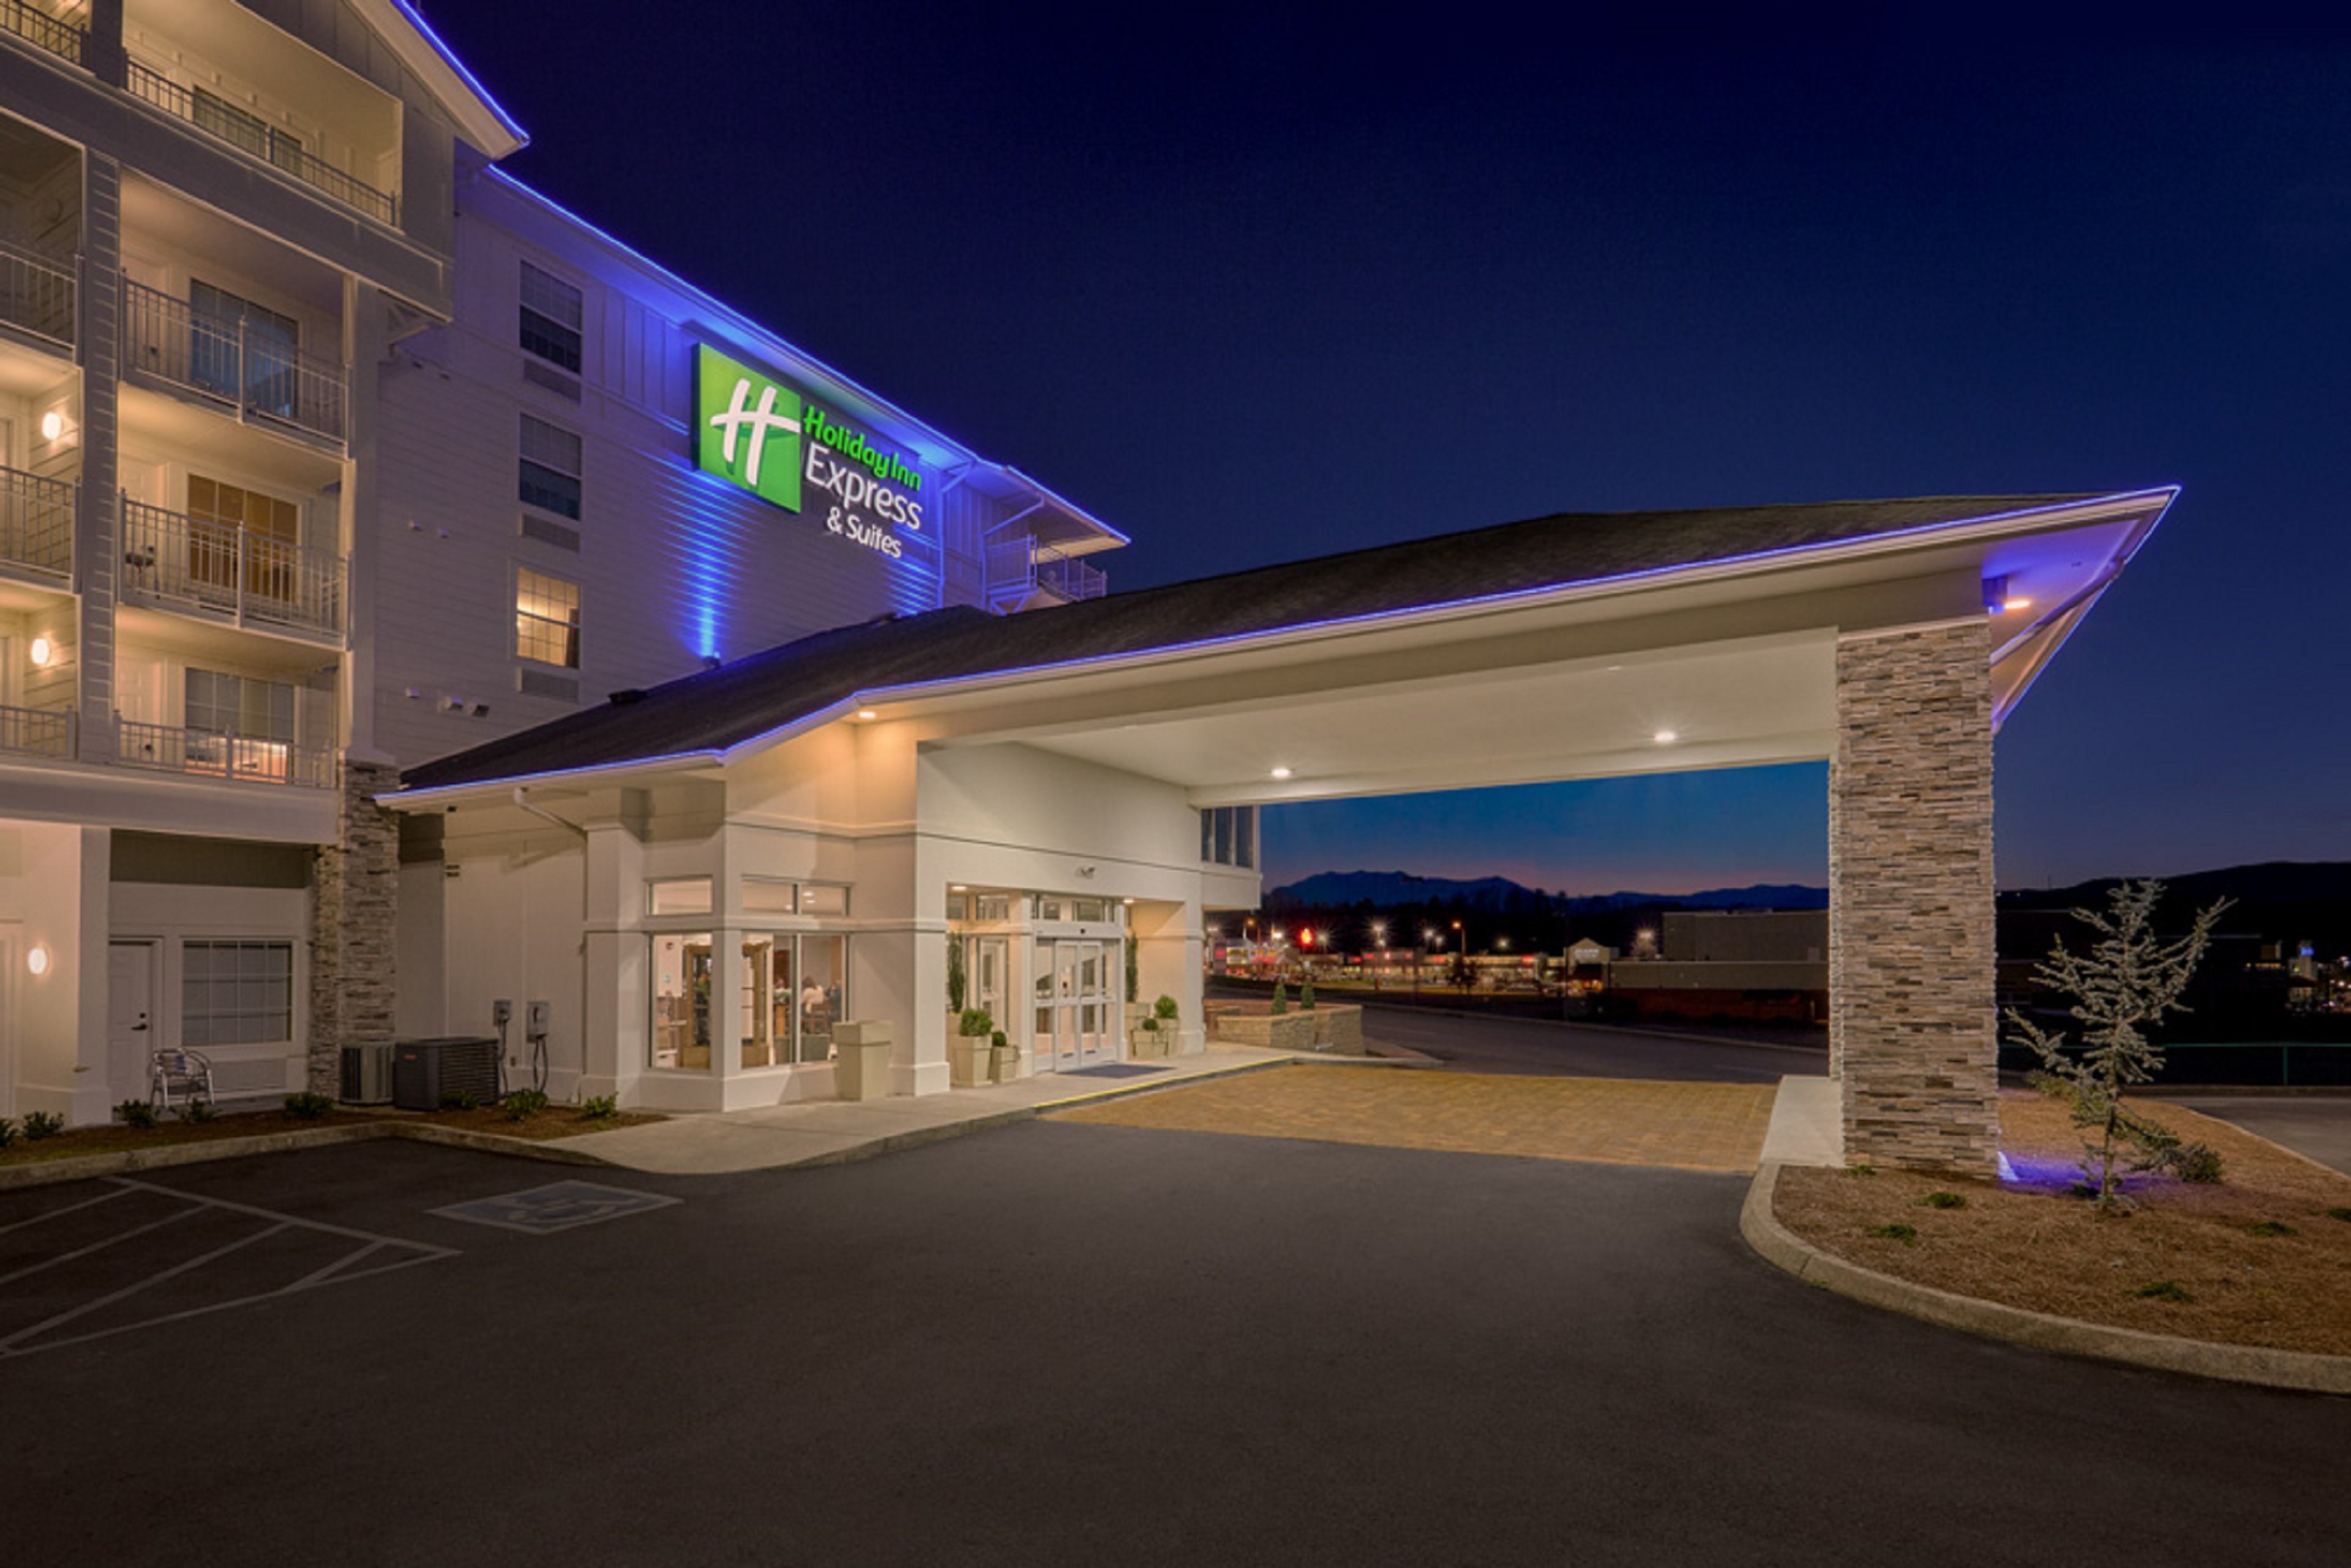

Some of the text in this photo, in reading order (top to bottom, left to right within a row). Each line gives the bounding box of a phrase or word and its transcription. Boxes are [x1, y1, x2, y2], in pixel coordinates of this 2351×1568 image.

[803, 405, 921, 491] Holiday Inn
[806, 441, 923, 530] Express
[827, 506, 902, 558] & Suites
